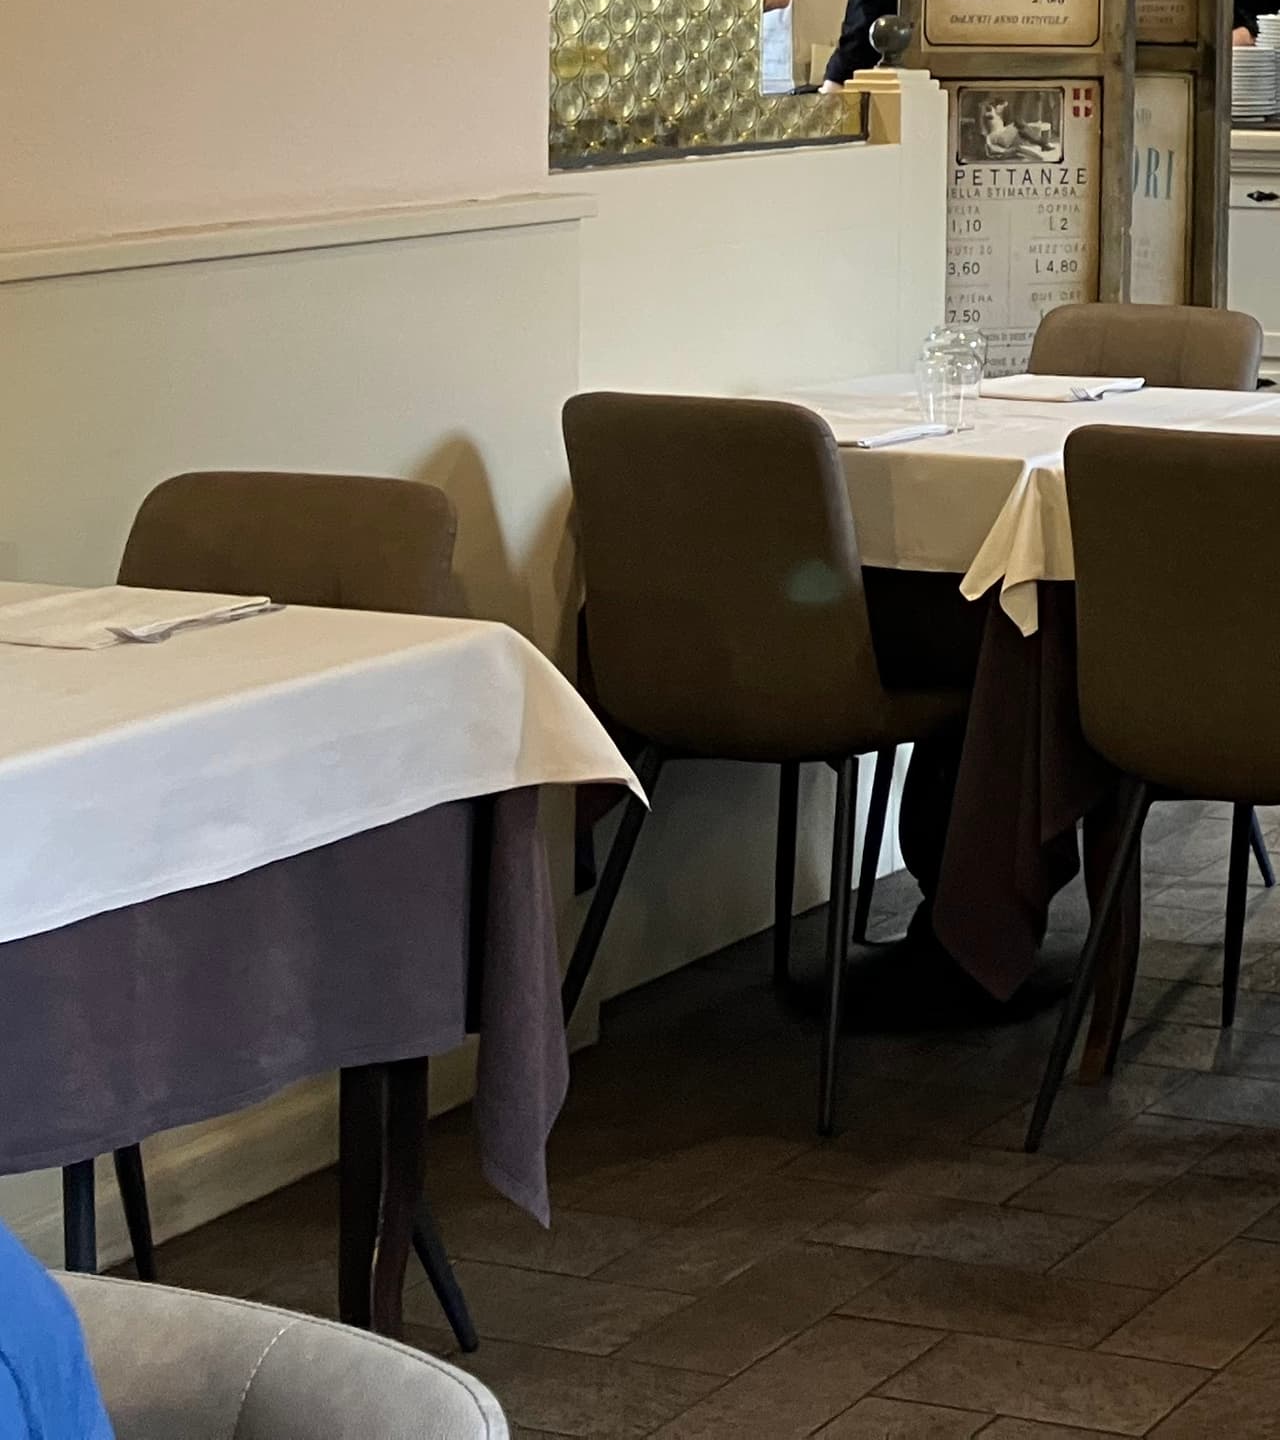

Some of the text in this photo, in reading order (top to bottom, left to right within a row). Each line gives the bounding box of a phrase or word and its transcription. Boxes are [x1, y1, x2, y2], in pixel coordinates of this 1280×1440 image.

[946, 186, 1076, 199] ELLA STIMATA CASA
[1038, 203, 1080, 214] DOPPIA
[1060, 218, 1068, 230] 2
[948, 262, 980, 276] 3,60
[1046, 259, 1078, 274] 4,80
[1031, 292, 1052, 302] DUE
